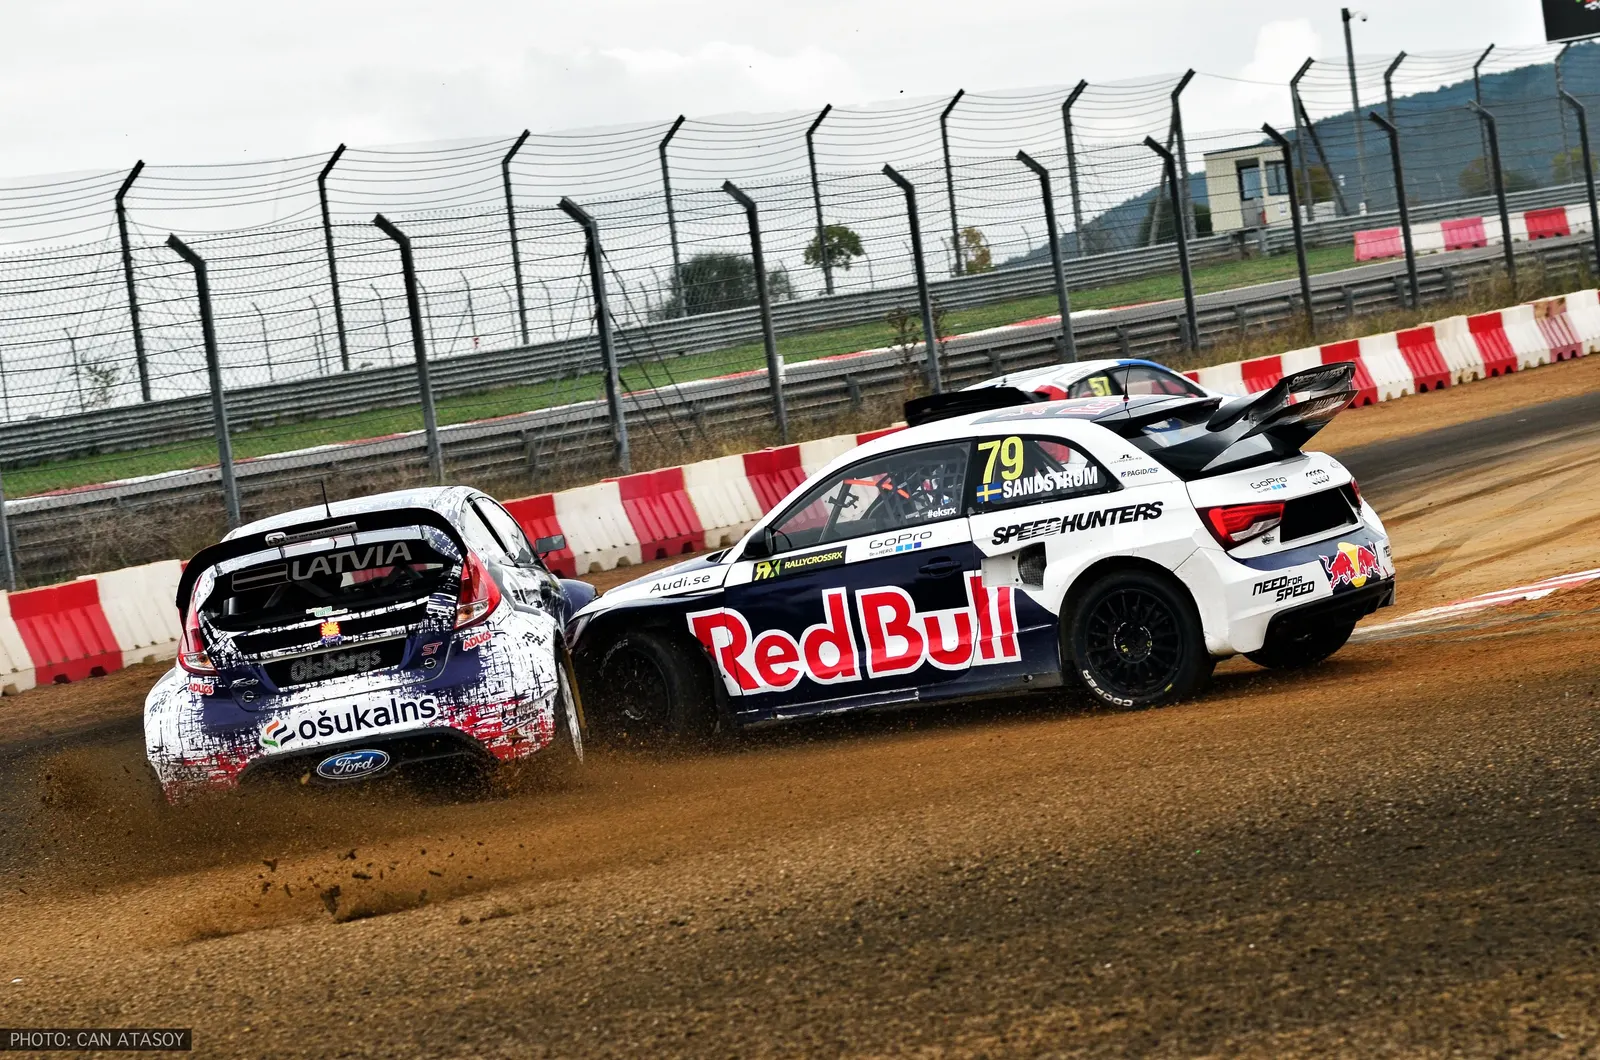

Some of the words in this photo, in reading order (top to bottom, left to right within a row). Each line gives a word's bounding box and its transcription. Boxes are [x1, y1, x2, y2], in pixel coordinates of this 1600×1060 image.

[1087, 376, 1113, 397] 57
[978, 436, 1024, 485] 79
[1250, 476, 1287, 490] GoPro
[927, 506, 957, 519] #eksrx
[991, 501, 1164, 546] SPEEDHUNTERS
[869, 530, 933, 550] GoPro
[292, 541, 413, 581] LATVIA
[784, 551, 844, 570] RALLYCROSSRX
[650, 573, 711, 593] Audi.se
[1252, 575, 1288, 596] NEED
[1286, 575, 1304, 587] FOR
[1275, 581, 1316, 603] SPEED
[462, 631, 492, 651] ADUGS
[688, 589, 860, 694] Red
[857, 573, 1019, 675] Bull
[422, 642, 443, 656] ST
[290, 648, 382, 683] Olsbergs
[187, 683, 214, 695] ADUGS
[1082, 669, 1134, 707] COOPER
[298, 698, 436, 740] ošukalns
[332, 754, 374, 776] Ford
